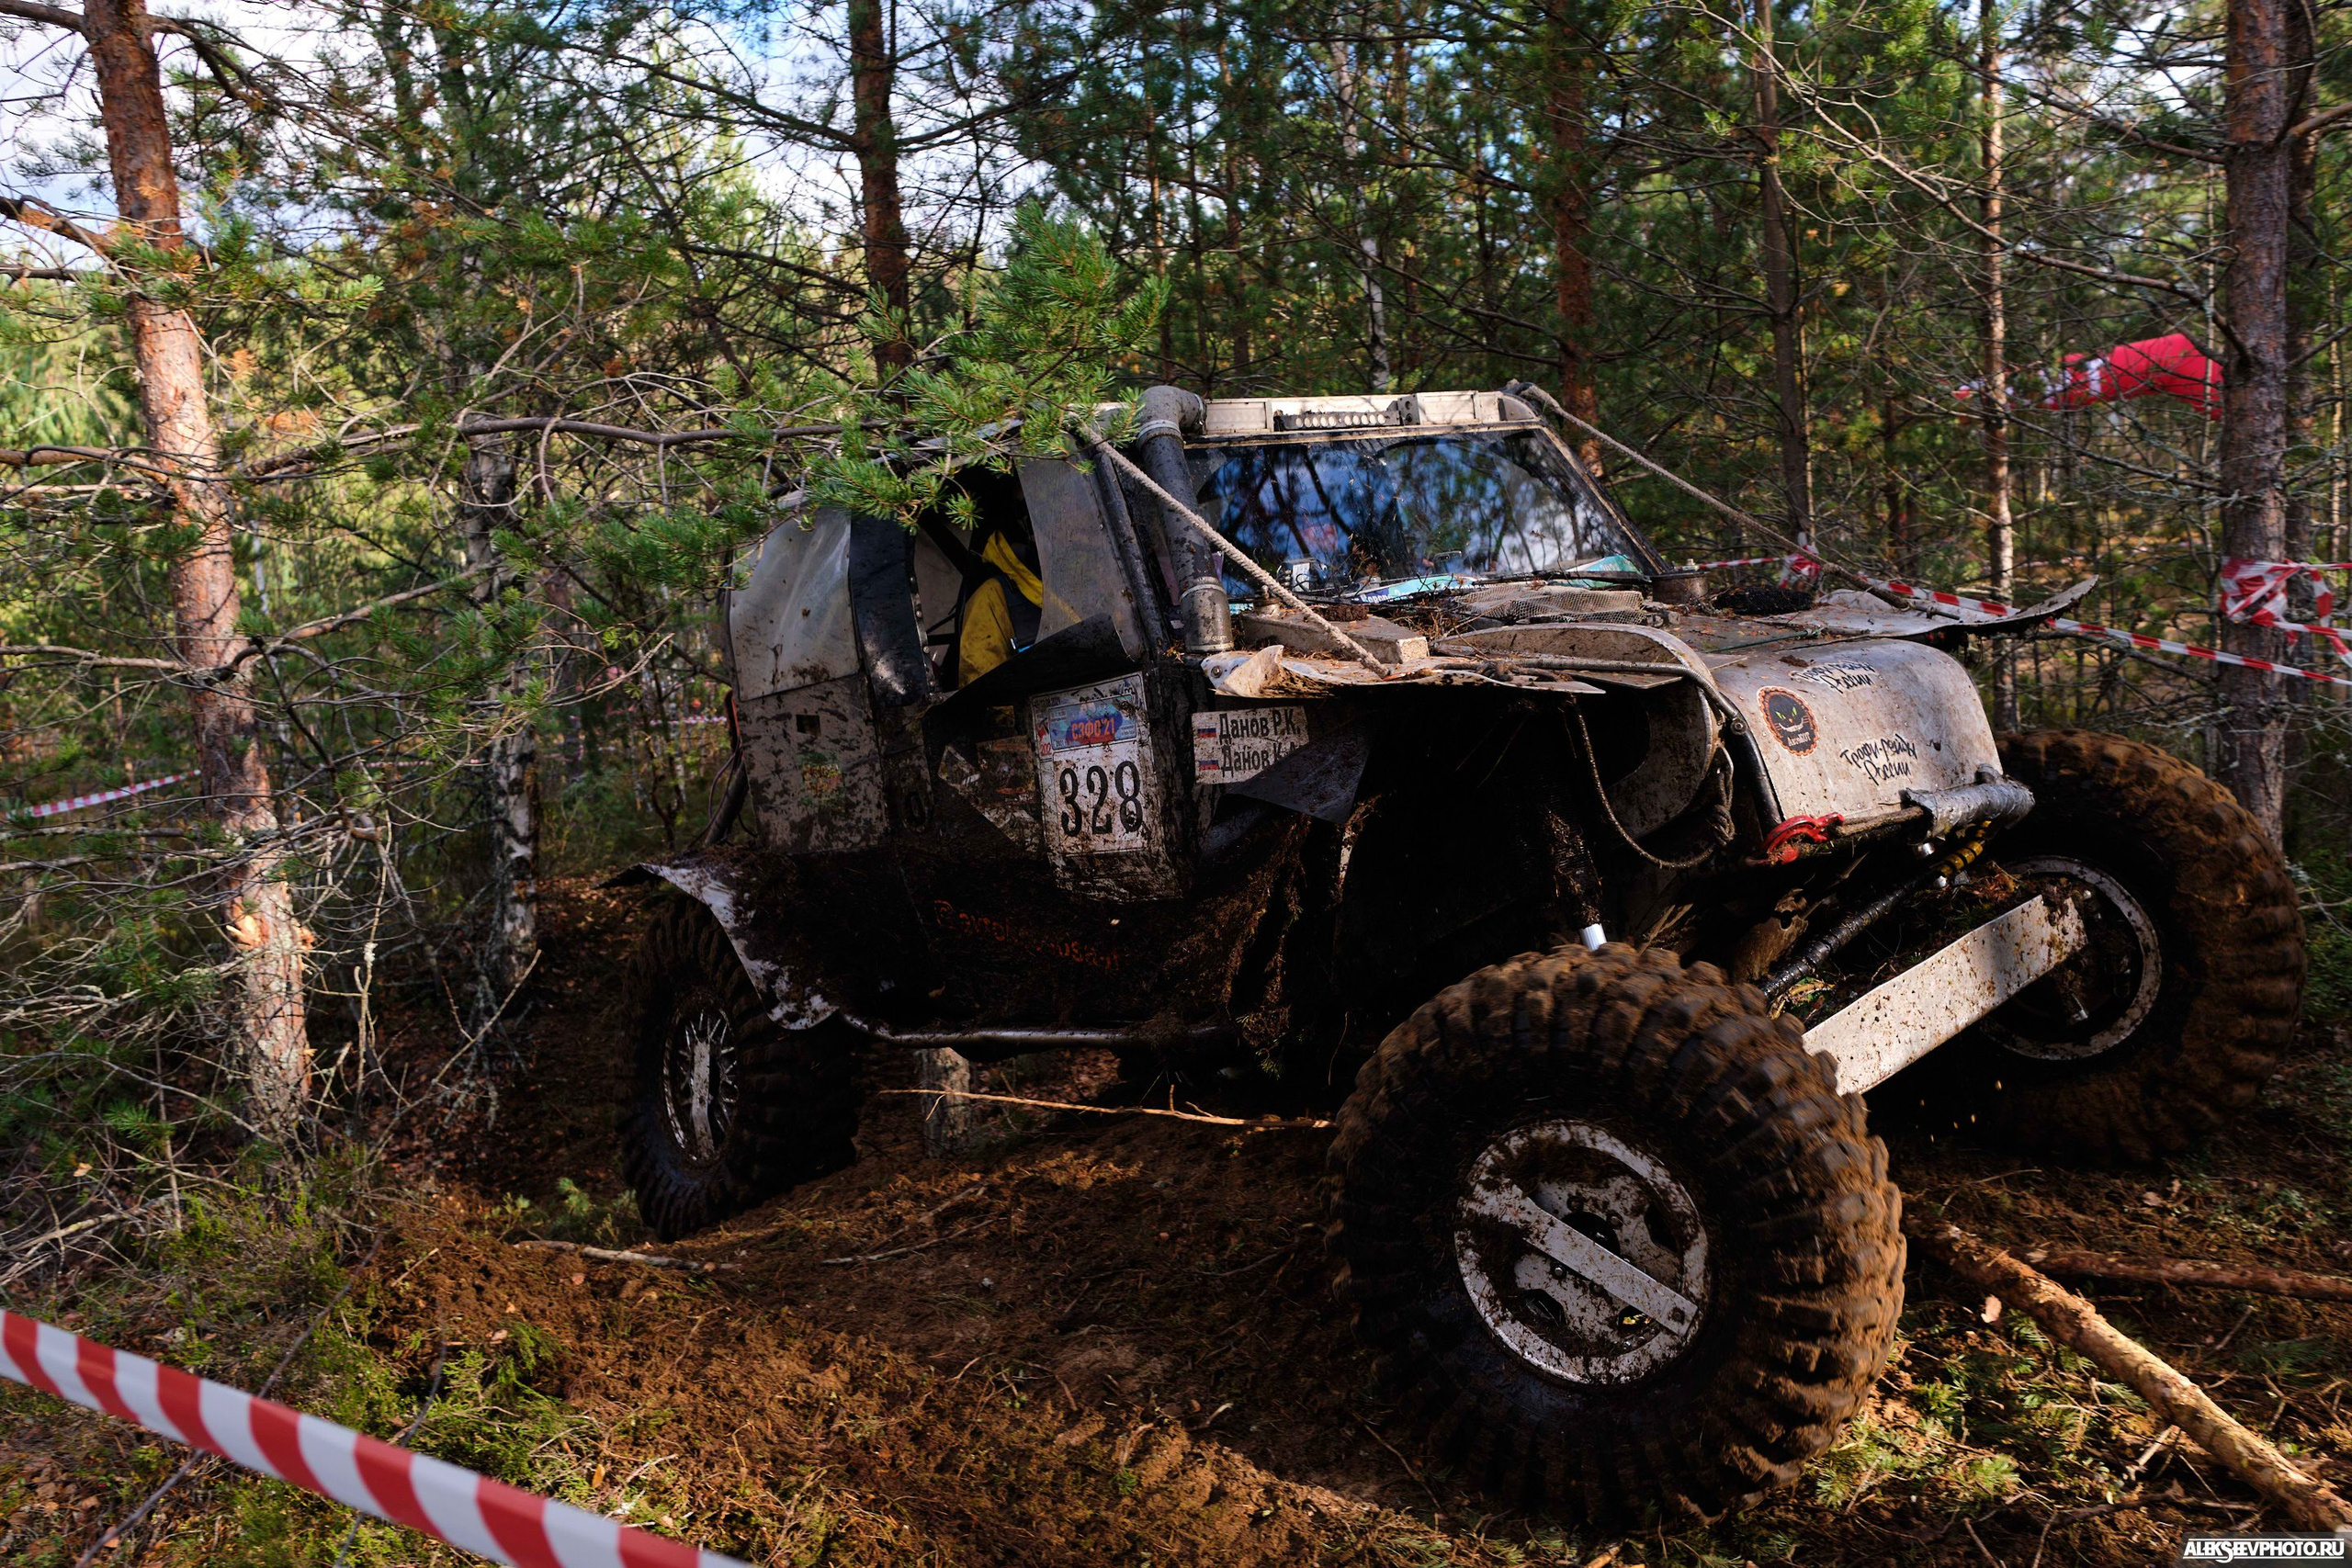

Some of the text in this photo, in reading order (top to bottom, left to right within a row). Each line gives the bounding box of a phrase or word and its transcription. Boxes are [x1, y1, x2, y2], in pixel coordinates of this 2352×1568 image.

[1219, 714, 1270, 745] Данов
[1221, 745, 1270, 778] Данов
[1059, 761, 1144, 837] 328
